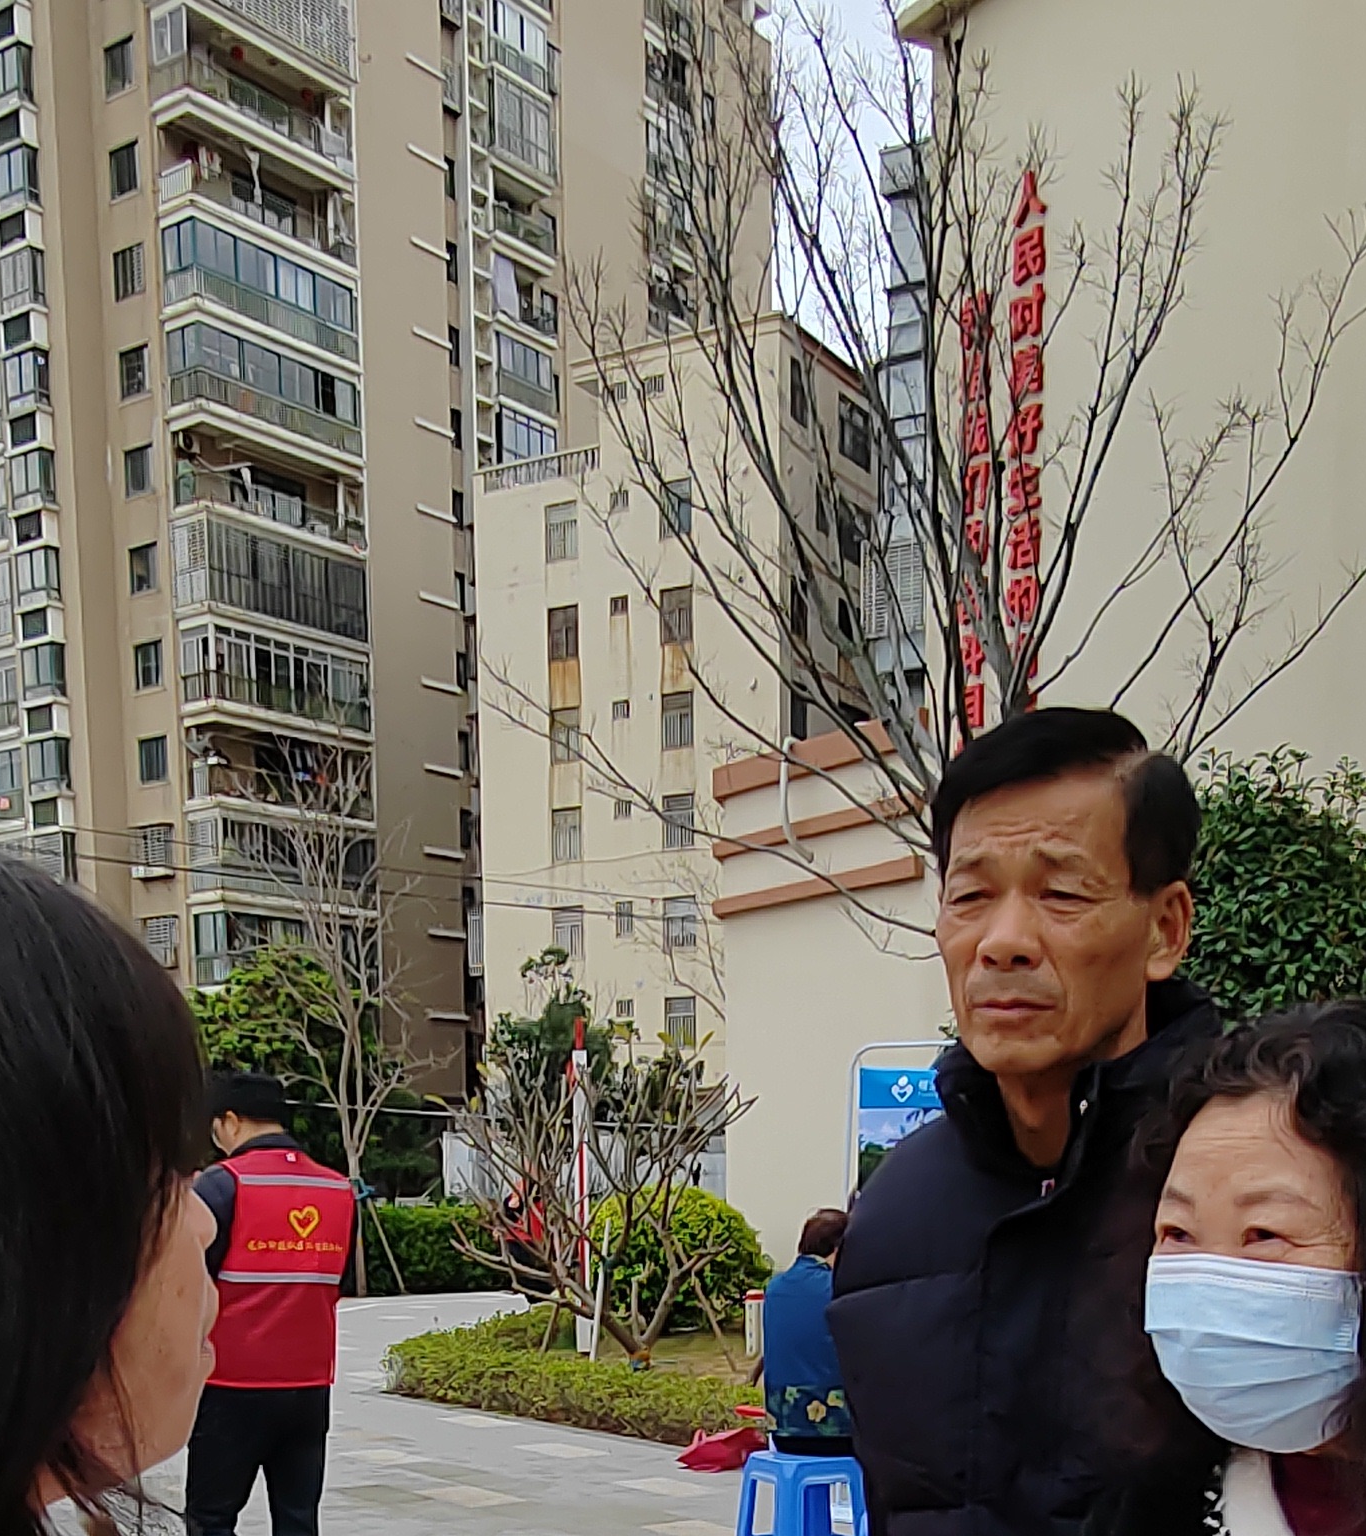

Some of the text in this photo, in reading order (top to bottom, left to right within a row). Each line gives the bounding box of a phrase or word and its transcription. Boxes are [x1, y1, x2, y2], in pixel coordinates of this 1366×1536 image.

[1002, 169, 1047, 714] 人民对美好生活的
